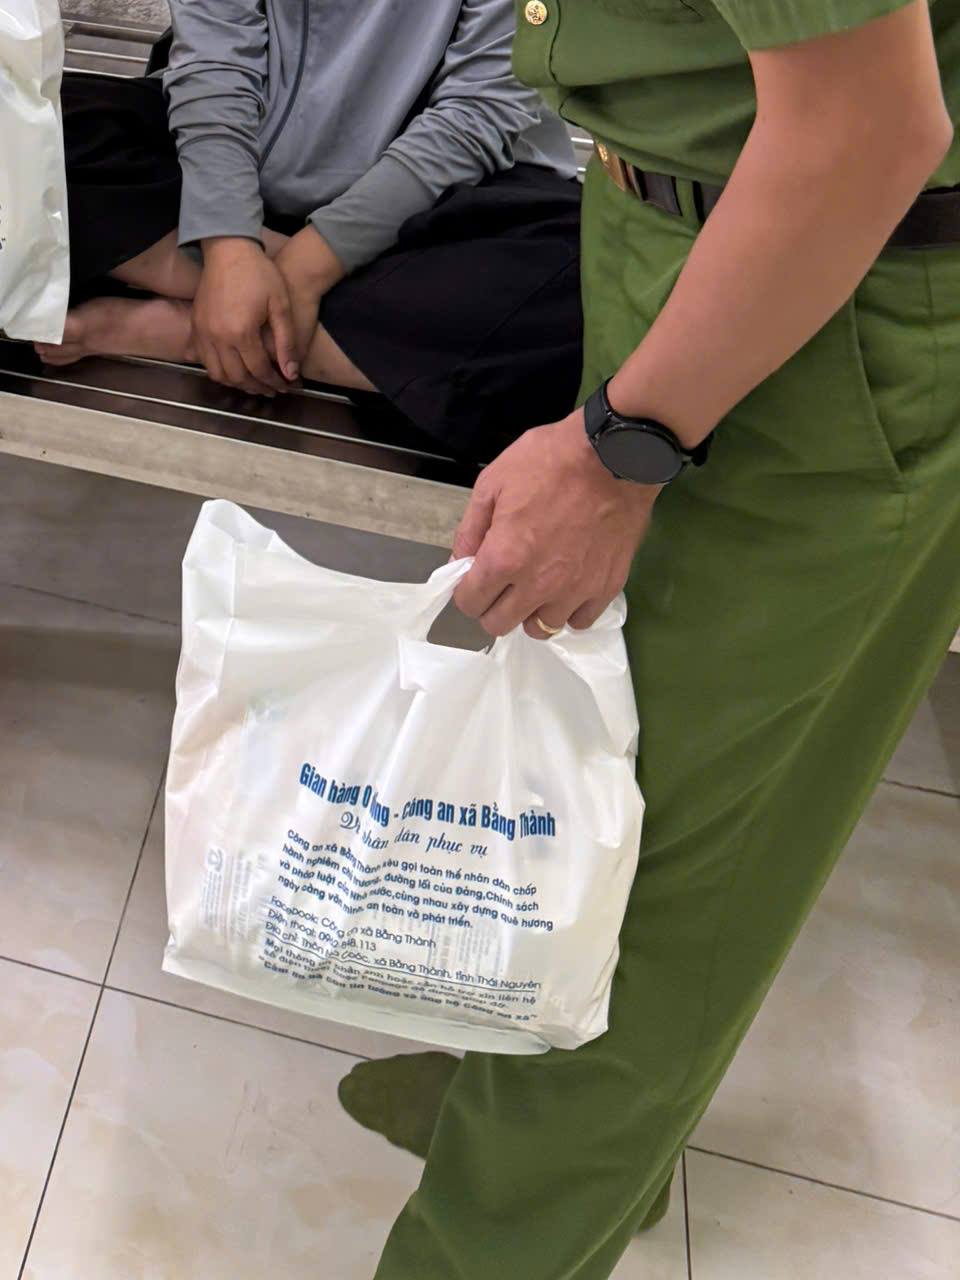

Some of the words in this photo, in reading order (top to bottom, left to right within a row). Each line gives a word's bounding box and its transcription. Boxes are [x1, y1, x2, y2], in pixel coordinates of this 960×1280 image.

[299, 762, 328, 798] Gian
[327, 779, 361, 806] hàng
[362, 784, 372, 808] 0
[402, 796, 433, 821] Công
[436, 801, 455, 824] an
[458, 803, 476, 827] xã
[480, 802, 516, 841] Bằng
[519, 809, 556, 839] Thành
[288, 829, 310, 851] Công
[312, 844, 323, 852] an
[401, 861, 417, 872] gọi
[420, 863, 443, 877] toàn
[445, 868, 462, 881] thể
[464, 871, 490, 885] nhân
[492, 877, 511, 893] dân
[513, 882, 537, 897] chấp
[394, 826, 420, 844] dân
[425, 832, 464, 855] phục
[470, 843, 488, 859] vụ
[278, 874, 300, 893] ngày
[301, 883, 325, 901] càng
[366, 902, 379, 911] an
[382, 902, 405, 917] toàn
[407, 908, 419, 920] và
[422, 913, 446, 926] phát
[448, 914, 473, 929] triển.
[280, 860, 290, 870] và
[292, 867, 315, 880] pháp
[317, 871, 336, 886] luật
[423, 896, 448, 910] nhau
[451, 900, 469, 913] xây
[472, 904, 499, 920] dựng
[501, 912, 519, 926] quê
[521, 918, 554, 932] hương
[283, 843, 304, 862] hành
[306, 857, 340, 871] nghiêm
[384, 872, 416, 889] đường
[418, 879, 431, 891] lối
[433, 881, 453, 895] của
[516, 901, 539, 912] sách
[360, 926, 373, 937] xã
[375, 927, 402, 944] Bằng
[405, 934, 437, 950] Thành
[374, 957, 387, 967] xã
[389, 958, 416, 973] Bằng
[477, 975, 498, 988] Thái
[500, 979, 542, 990] Nguyên
